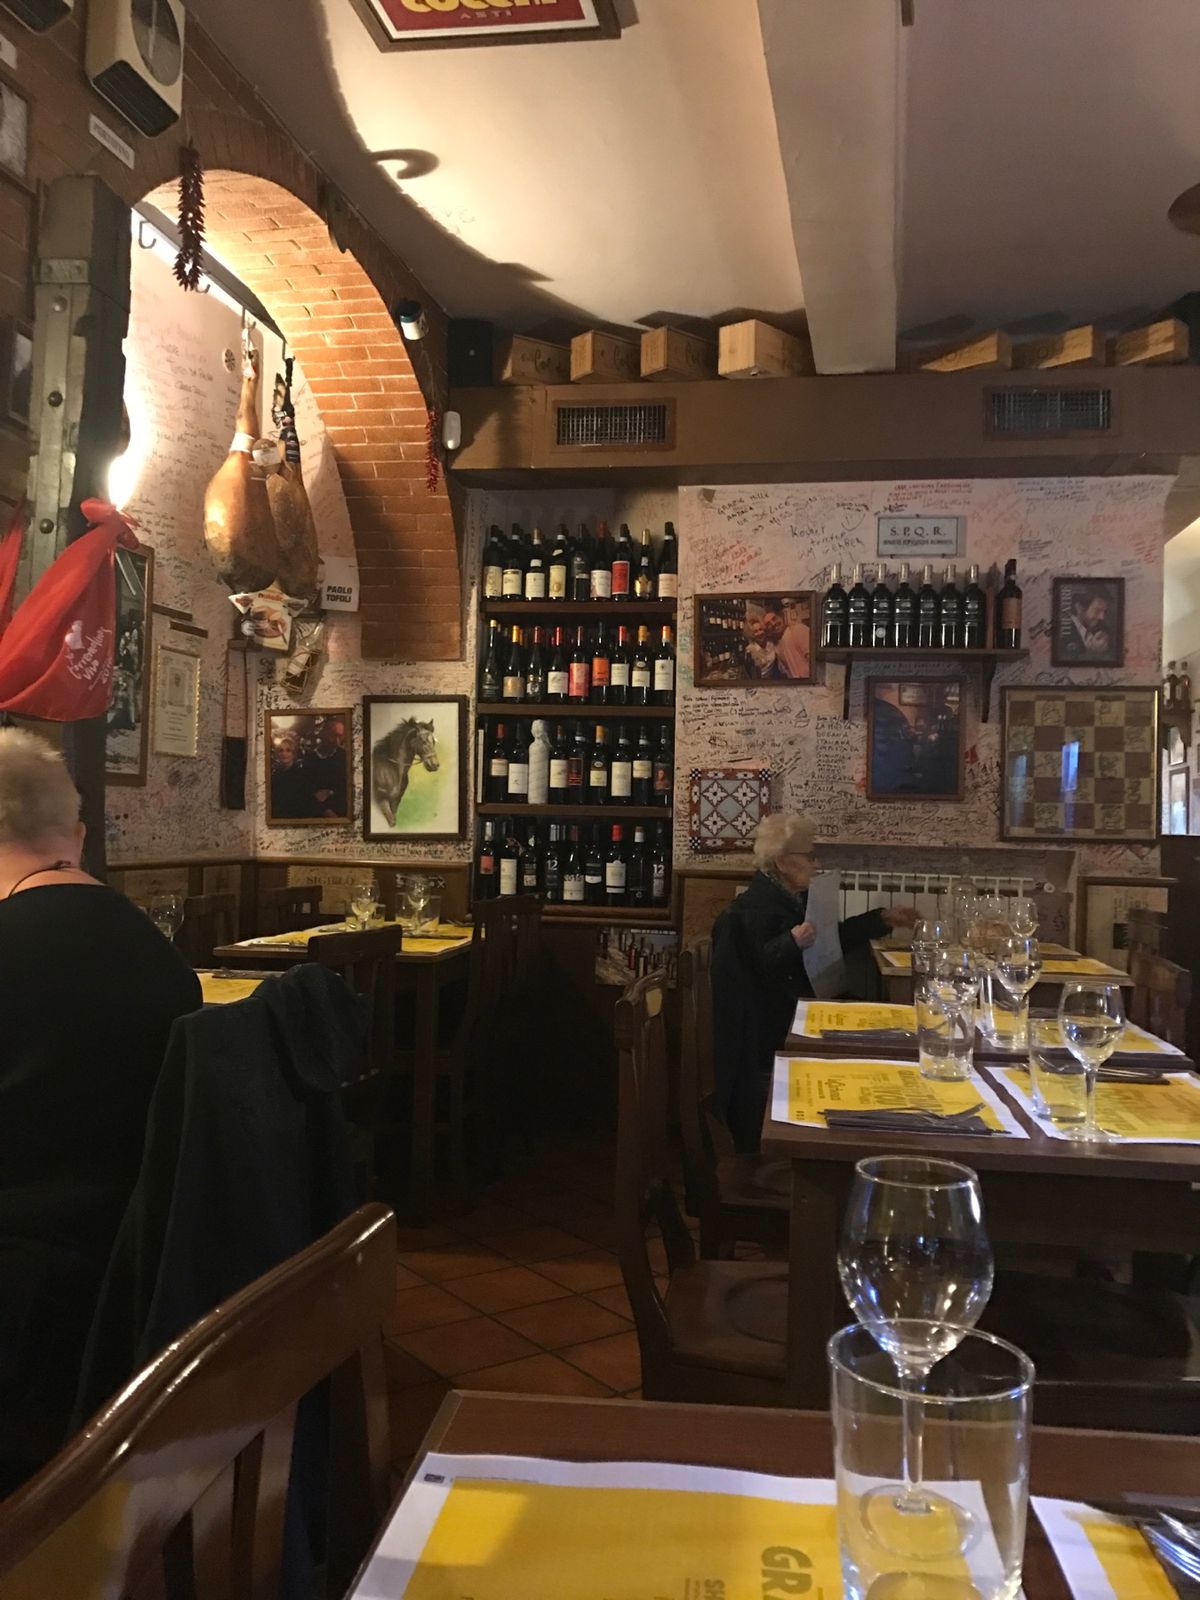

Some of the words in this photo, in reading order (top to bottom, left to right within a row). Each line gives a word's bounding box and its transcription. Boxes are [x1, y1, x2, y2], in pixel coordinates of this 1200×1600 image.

[460, 10, 512, 19] ASTI
[326, 585, 353, 595] PAOLO
[546, 860, 558, 871] 12
[653, 864, 664, 874] 12
